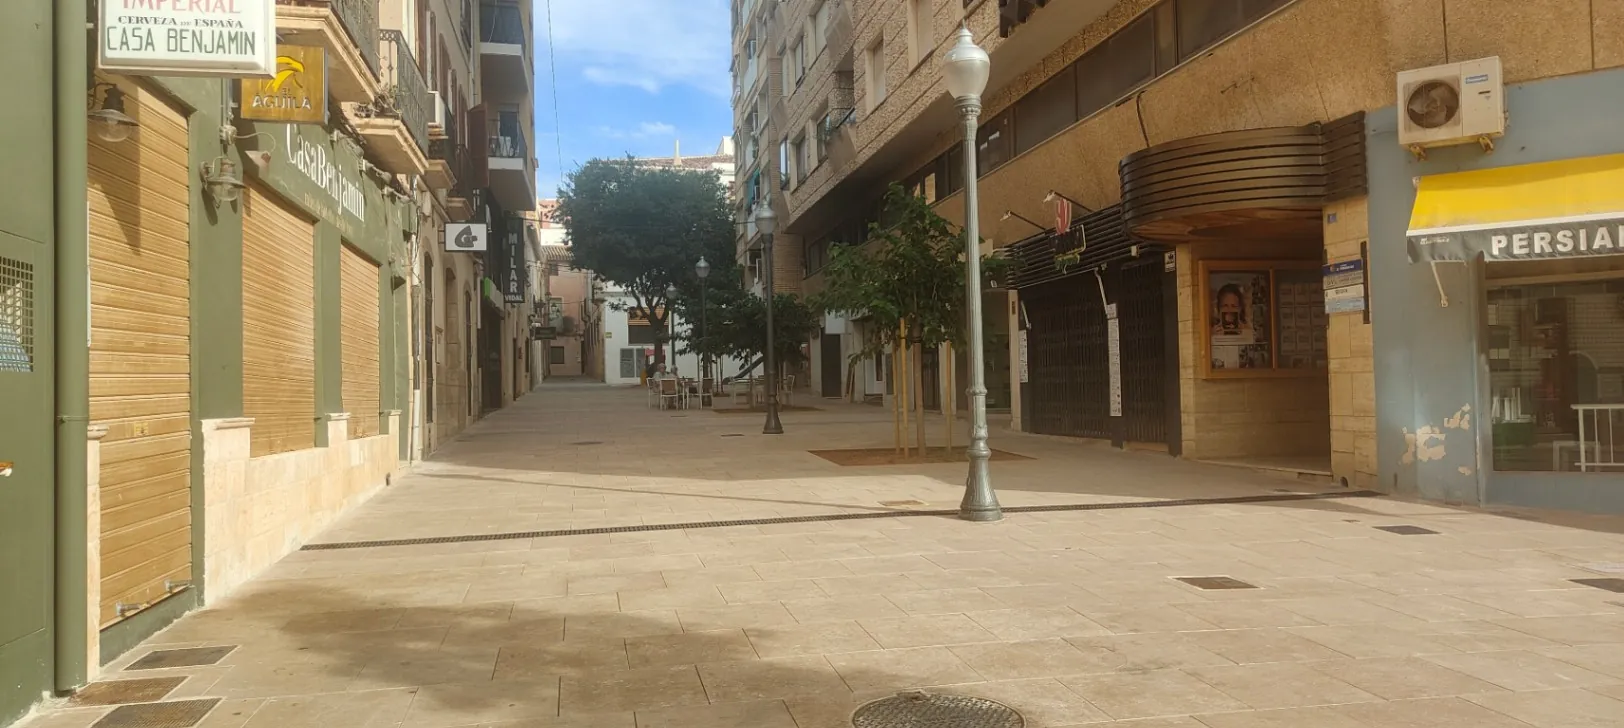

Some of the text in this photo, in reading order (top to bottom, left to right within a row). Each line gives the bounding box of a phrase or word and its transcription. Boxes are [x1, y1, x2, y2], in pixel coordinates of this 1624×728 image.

[118, 15, 178, 26] CERVEZA
[194, 18, 243, 29] ESPAÑA
[106, 26, 256, 55] CASA BENJAMIN
[1491, 224, 1624, 256] PERSIA
[508, 232, 518, 293] MILAR
